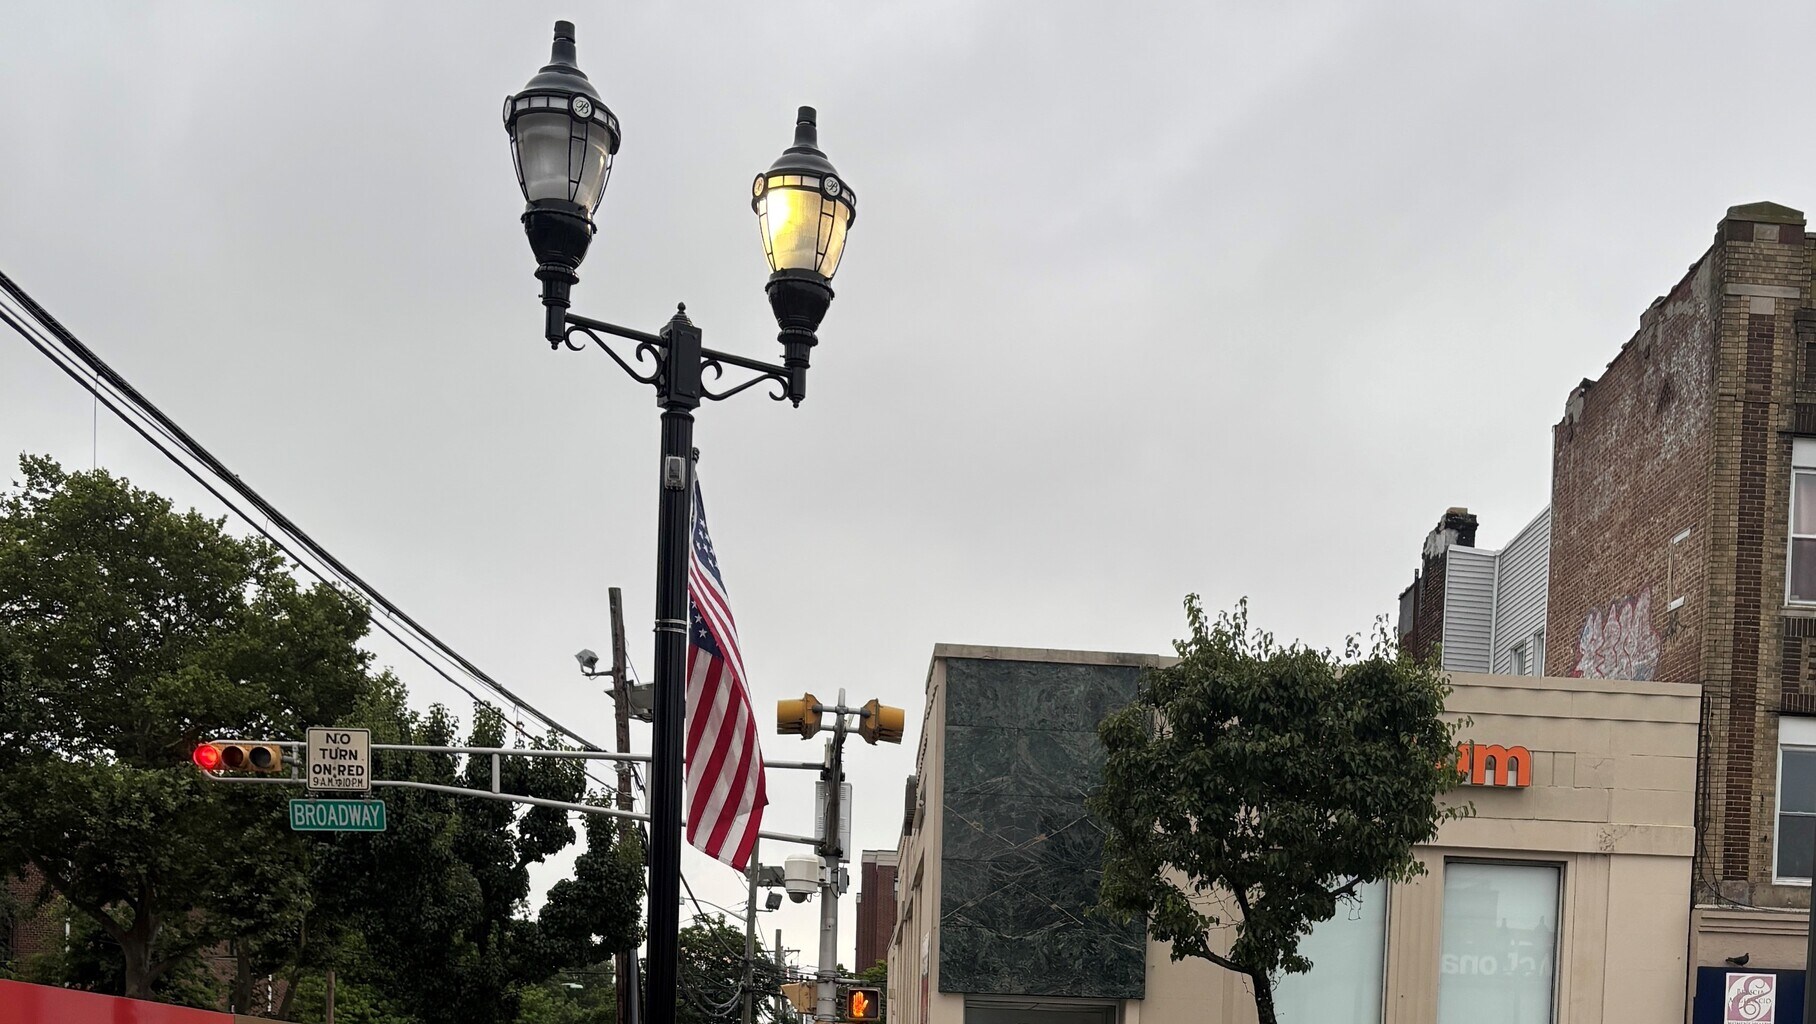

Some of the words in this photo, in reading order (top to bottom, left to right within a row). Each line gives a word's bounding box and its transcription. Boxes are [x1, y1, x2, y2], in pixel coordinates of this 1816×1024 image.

[326, 733, 351, 744] NO
[319, 748, 358, 760] TURN
[312, 764, 332, 775] ON
[338, 765, 365, 776] RED
[294, 804, 380, 827] BROADWAY
